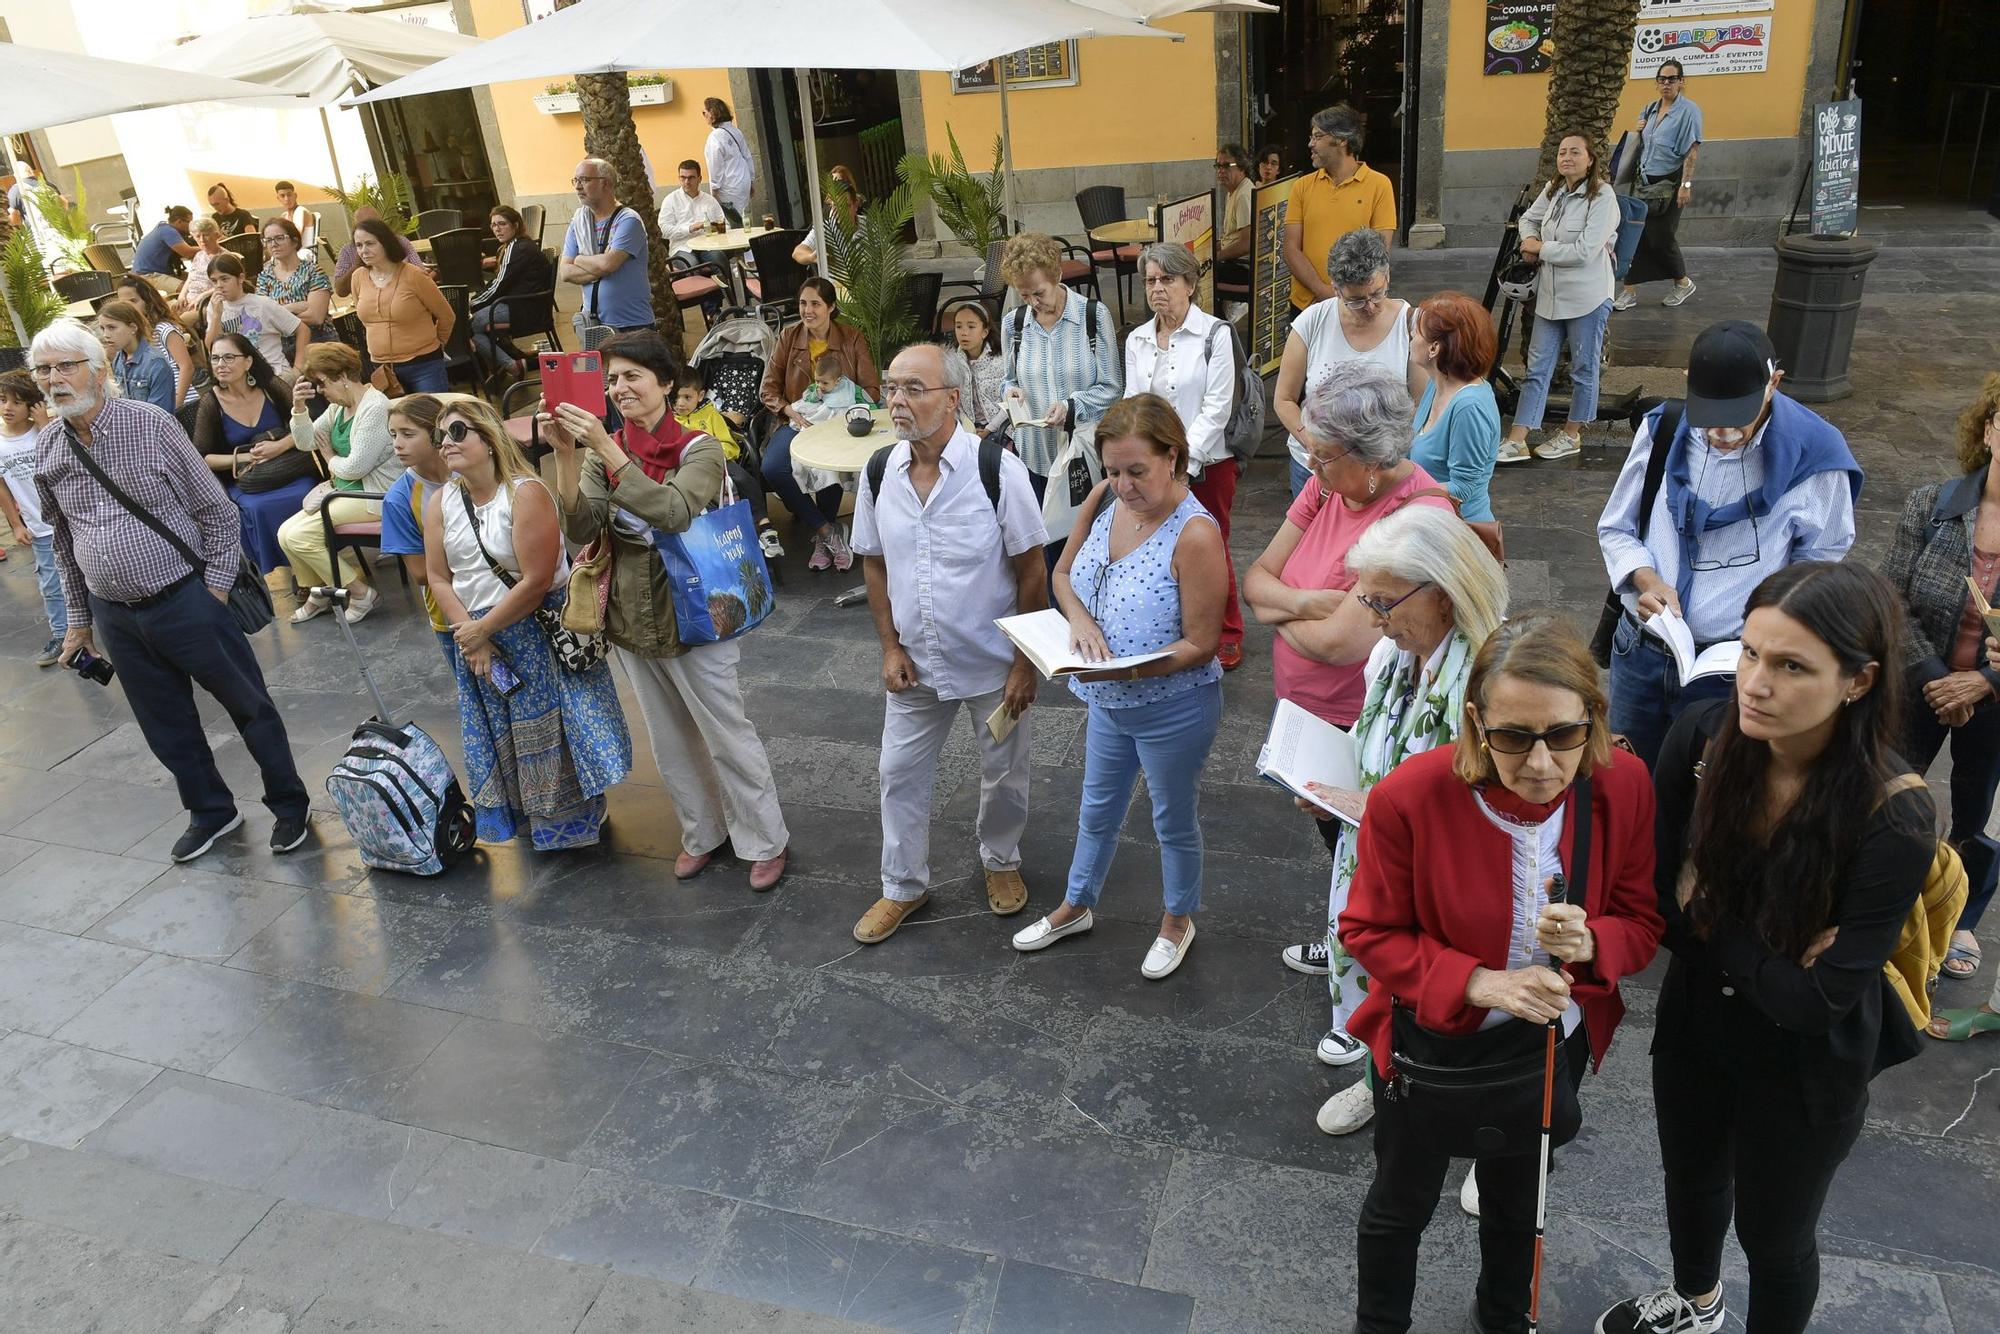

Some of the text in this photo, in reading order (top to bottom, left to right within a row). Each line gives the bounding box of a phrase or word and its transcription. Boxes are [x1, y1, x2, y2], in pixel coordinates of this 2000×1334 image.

[1502, 5, 1538, 14] COMIDA
[1663, 24, 1765, 46] HAPPYPOL
[1635, 56, 1676, 64] LUDOTECA
[1819, 106, 1840, 137] Café
[1820, 132, 1855, 156] MOVIE
[1818, 153, 1850, 172] abierto
